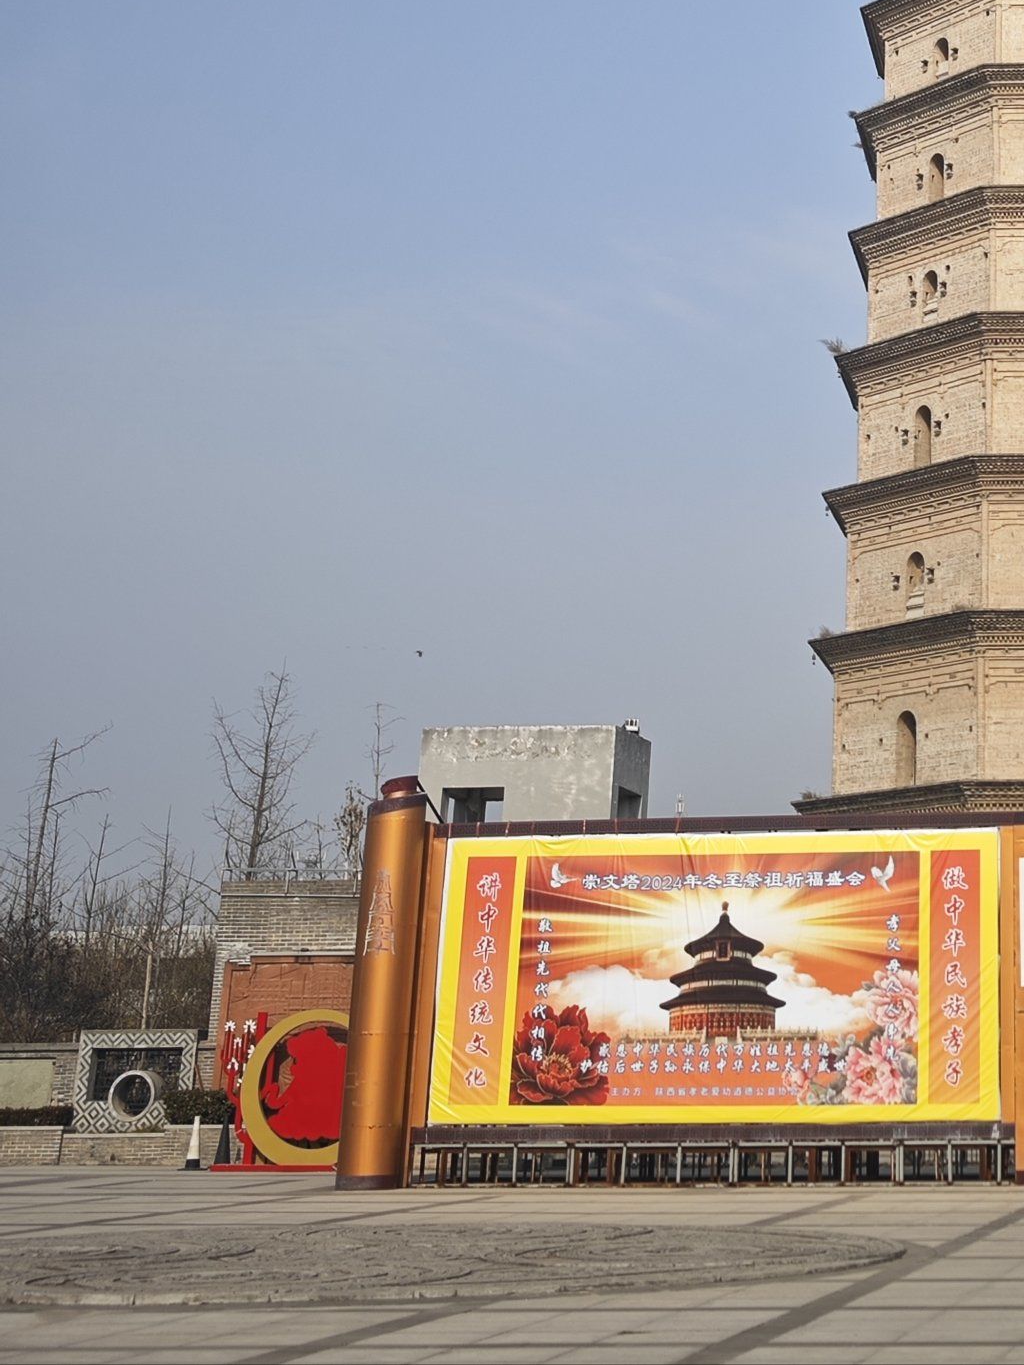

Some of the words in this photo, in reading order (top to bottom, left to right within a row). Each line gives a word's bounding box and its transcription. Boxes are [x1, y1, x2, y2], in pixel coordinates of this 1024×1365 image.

[463, 872, 502, 1089] 讲中华传统文化
[530, 917, 553, 1062] 敬祖先代代相传
[941, 865, 970, 1087] 做中华民族孝子
